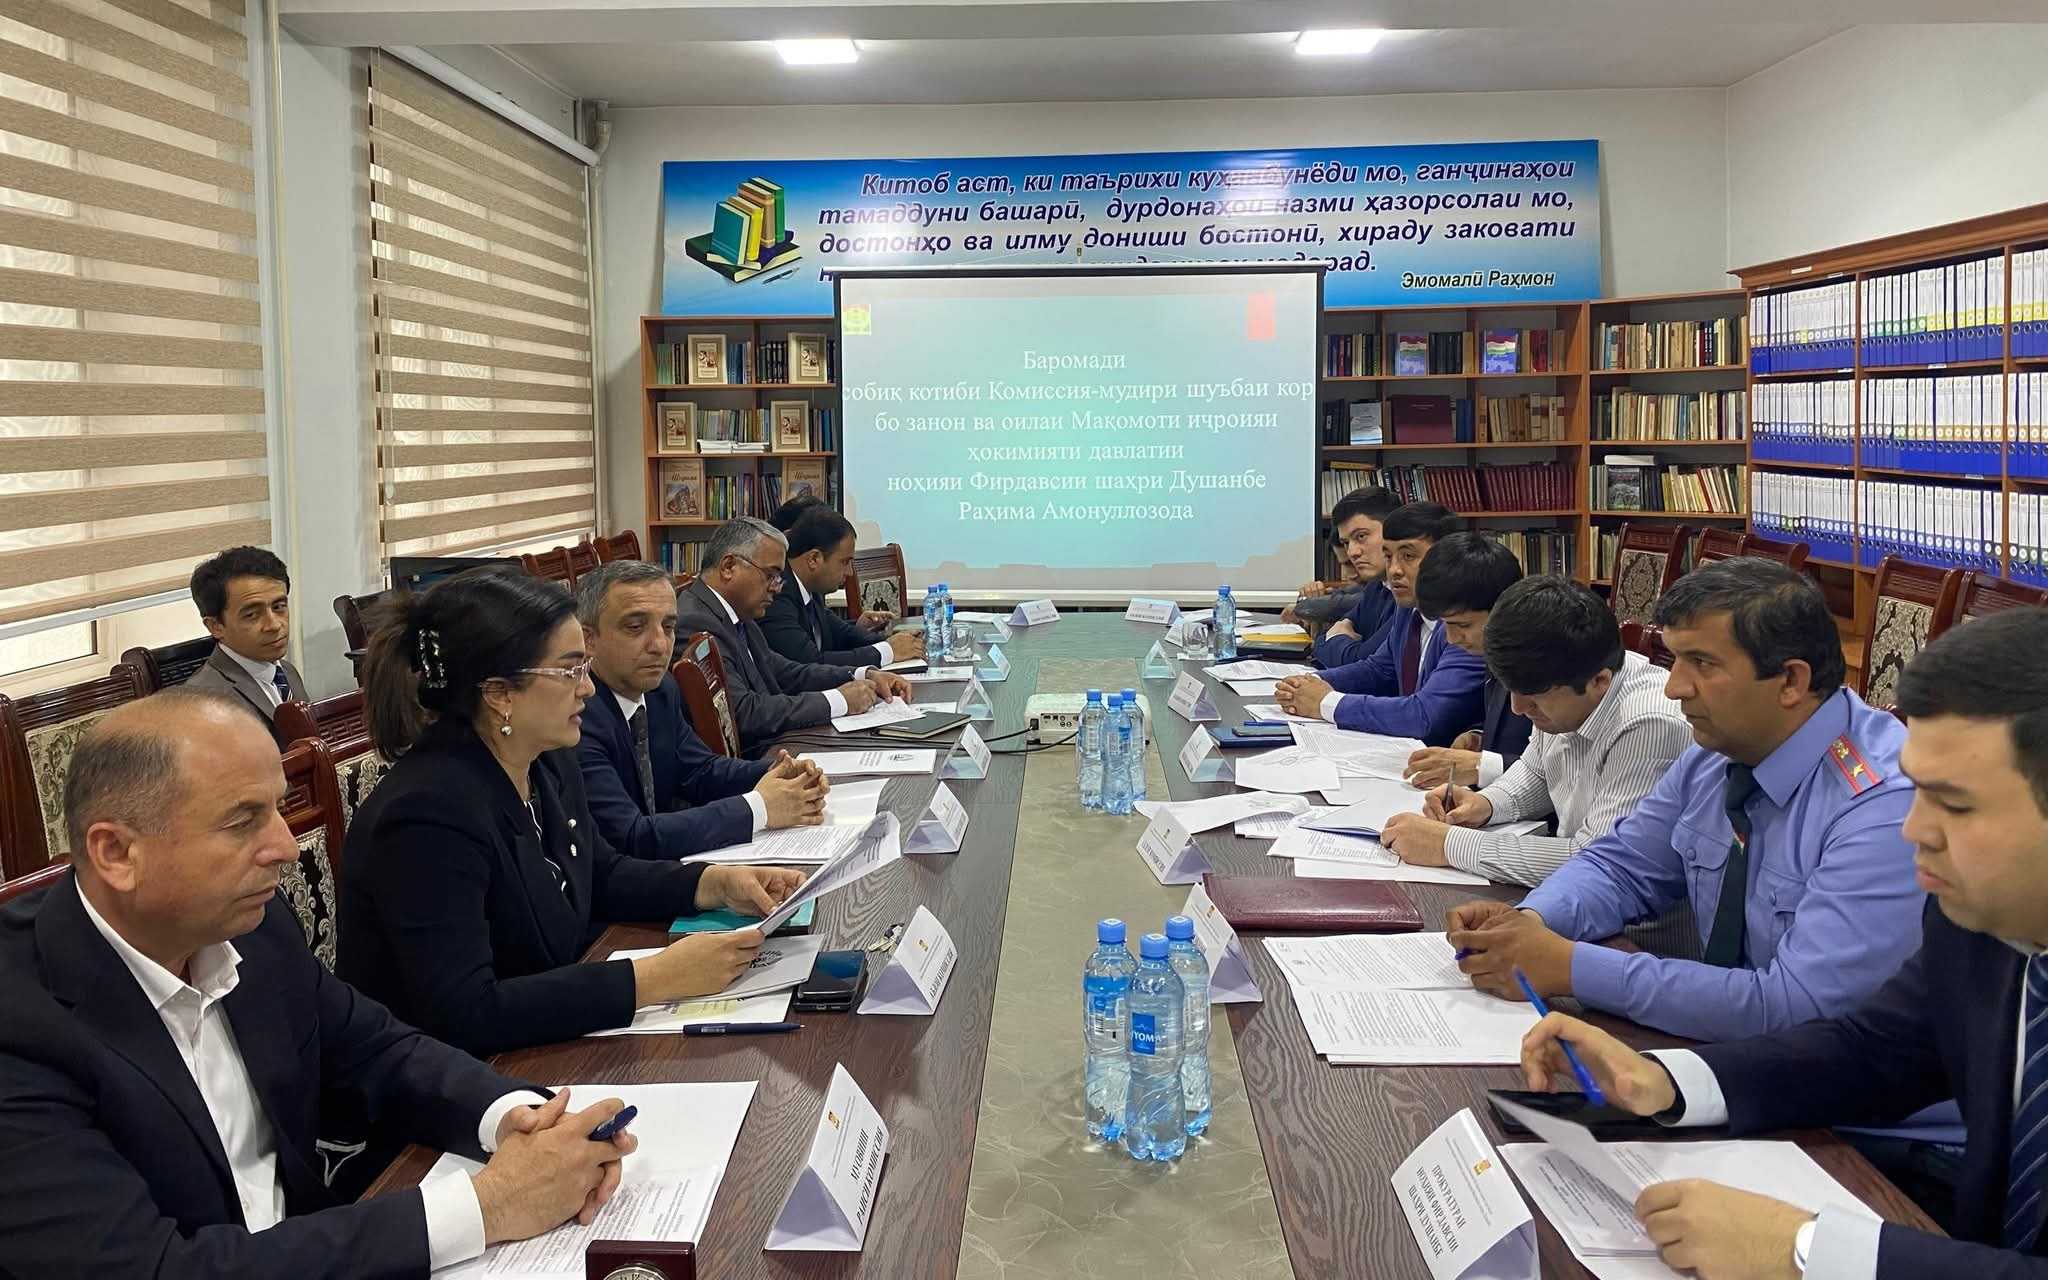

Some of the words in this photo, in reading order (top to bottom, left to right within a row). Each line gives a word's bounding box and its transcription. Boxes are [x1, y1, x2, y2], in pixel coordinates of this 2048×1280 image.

[862, 171, 951, 197] Китоб
[957, 173, 1016, 196] аст,
[1023, 172, 1051, 193] ки
[1058, 167, 1180, 193] таърихи
[1188, 161, 1358, 192] куҳунёди
[1366, 164, 1409, 184] мо,
[1416, 159, 1575, 186] ганҷинаҳои
[818, 203, 969, 228] тамаддуни
[979, 200, 1086, 226] башарӣ,
[1274, 193, 1355, 215] назми
[1364, 188, 1520, 215] ҳазорсолаи
[1531, 192, 1574, 212] мо,
[819, 232, 952, 257] достонҳо
[964, 236, 993, 253] ва
[1004, 231, 1073, 256] илму
[1085, 224, 1187, 250] дониши
[1199, 221, 1326, 249] бостонӣ,
[1337, 221, 1434, 246] хираду
[1444, 217, 1575, 239] заковати
[1401, 270, 1485, 289] Эмомалӣ
[1488, 269, 1556, 290] Раҳмон
[1023, 350, 1126, 374] Баромади
[909, 381, 982, 403] котиби
[988, 380, 1178, 405] Комиссия-мудири
[1186, 376, 1270, 401] шуъбаи
[1277, 378, 1314, 401] кор
[874, 410, 900, 431] бо
[908, 414, 966, 431] занон
[973, 414, 995, 430] ва
[1001, 412, 1064, 431] оилаи
[1071, 409, 1182, 432] Мақомоти
[967, 444, 1081, 463] ҳокимияти
[1088, 443, 1185, 462] давлатии
[887, 476, 963, 493] ноҳияи
[970, 471, 1087, 495] Фирдавсии
[1095, 473, 1165, 494] шаҳри
[1169, 469, 1267, 493] Душанбе
[958, 501, 1036, 523] Раҳима
[1041, 499, 1195, 524] Амонуллозода
